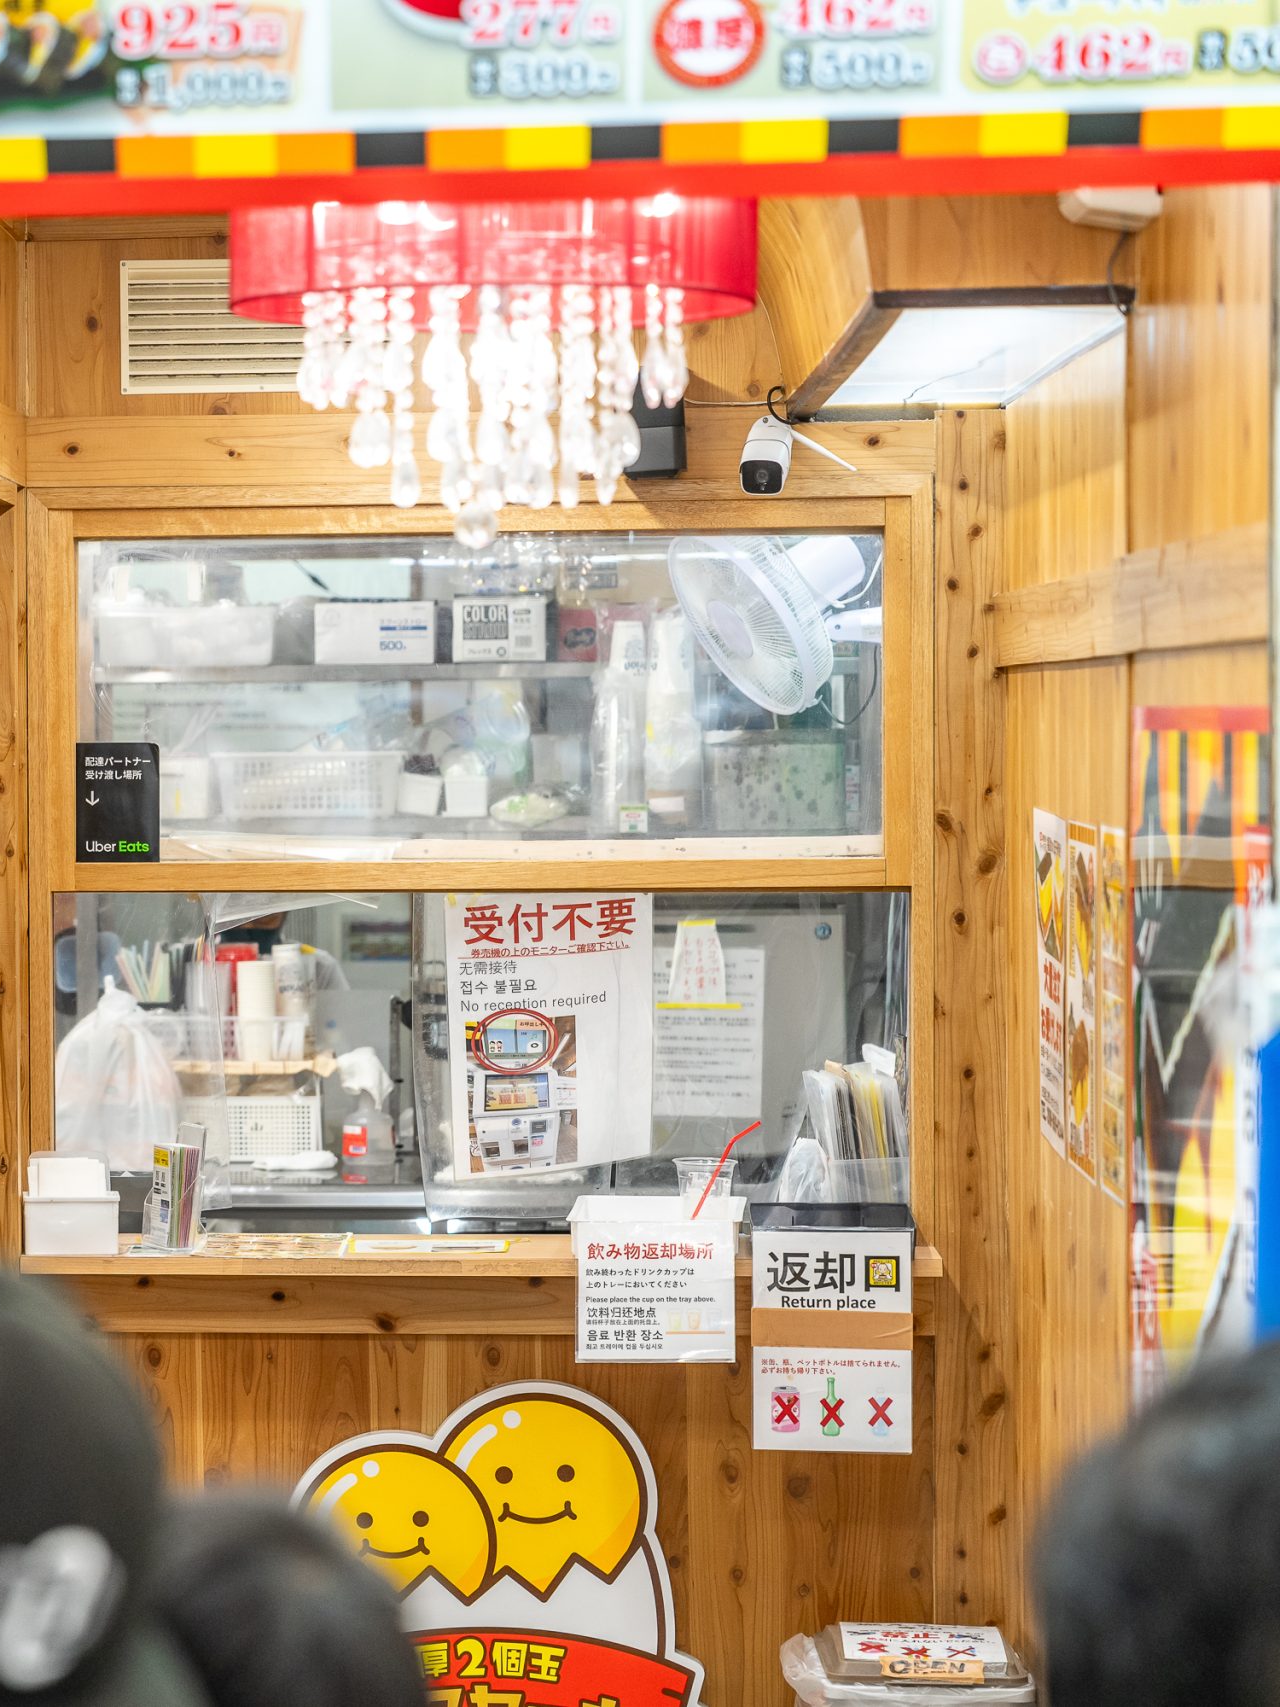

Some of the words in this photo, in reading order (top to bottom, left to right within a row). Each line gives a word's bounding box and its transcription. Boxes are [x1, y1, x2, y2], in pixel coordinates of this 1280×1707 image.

[464, 605, 508, 622] COLOR
[85, 756, 151, 767] 配達パートナー
[85, 770, 142, 780] 受け渡し場所
[85, 840, 117, 852] Uber
[118, 840, 150, 852] Eats
[464, 898, 636, 945] 受付不要
[471, 941, 631, 958] 券売機の上のモニターご確認下さい。
[459, 960, 517, 976] 无需接待
[460, 980, 489, 996] 접수
[493, 979, 537, 995] 불필요
[460, 1000, 479, 1012] No
[484, 998, 548, 1012] reception
[552, 990, 607, 1008] required
[587, 1243, 714, 1260] 飲み物返却場所
[586, 1268, 695, 1277] 飲み終わったドリンクカップは
[767, 1251, 901, 1294] 返却口
[586, 1281, 687, 1289] 上のトレーにおいてください
[609, 1296, 628, 1304] place
[679, 1296, 692, 1304] tray
[781, 1295, 832, 1309] Return
[836, 1296, 876, 1311] place
[587, 1307, 656, 1318] 饮料归还地点
[587, 1329, 610, 1341] 음료
[614, 1329, 637, 1341] 반환
[640, 1329, 663, 1341] 장소
